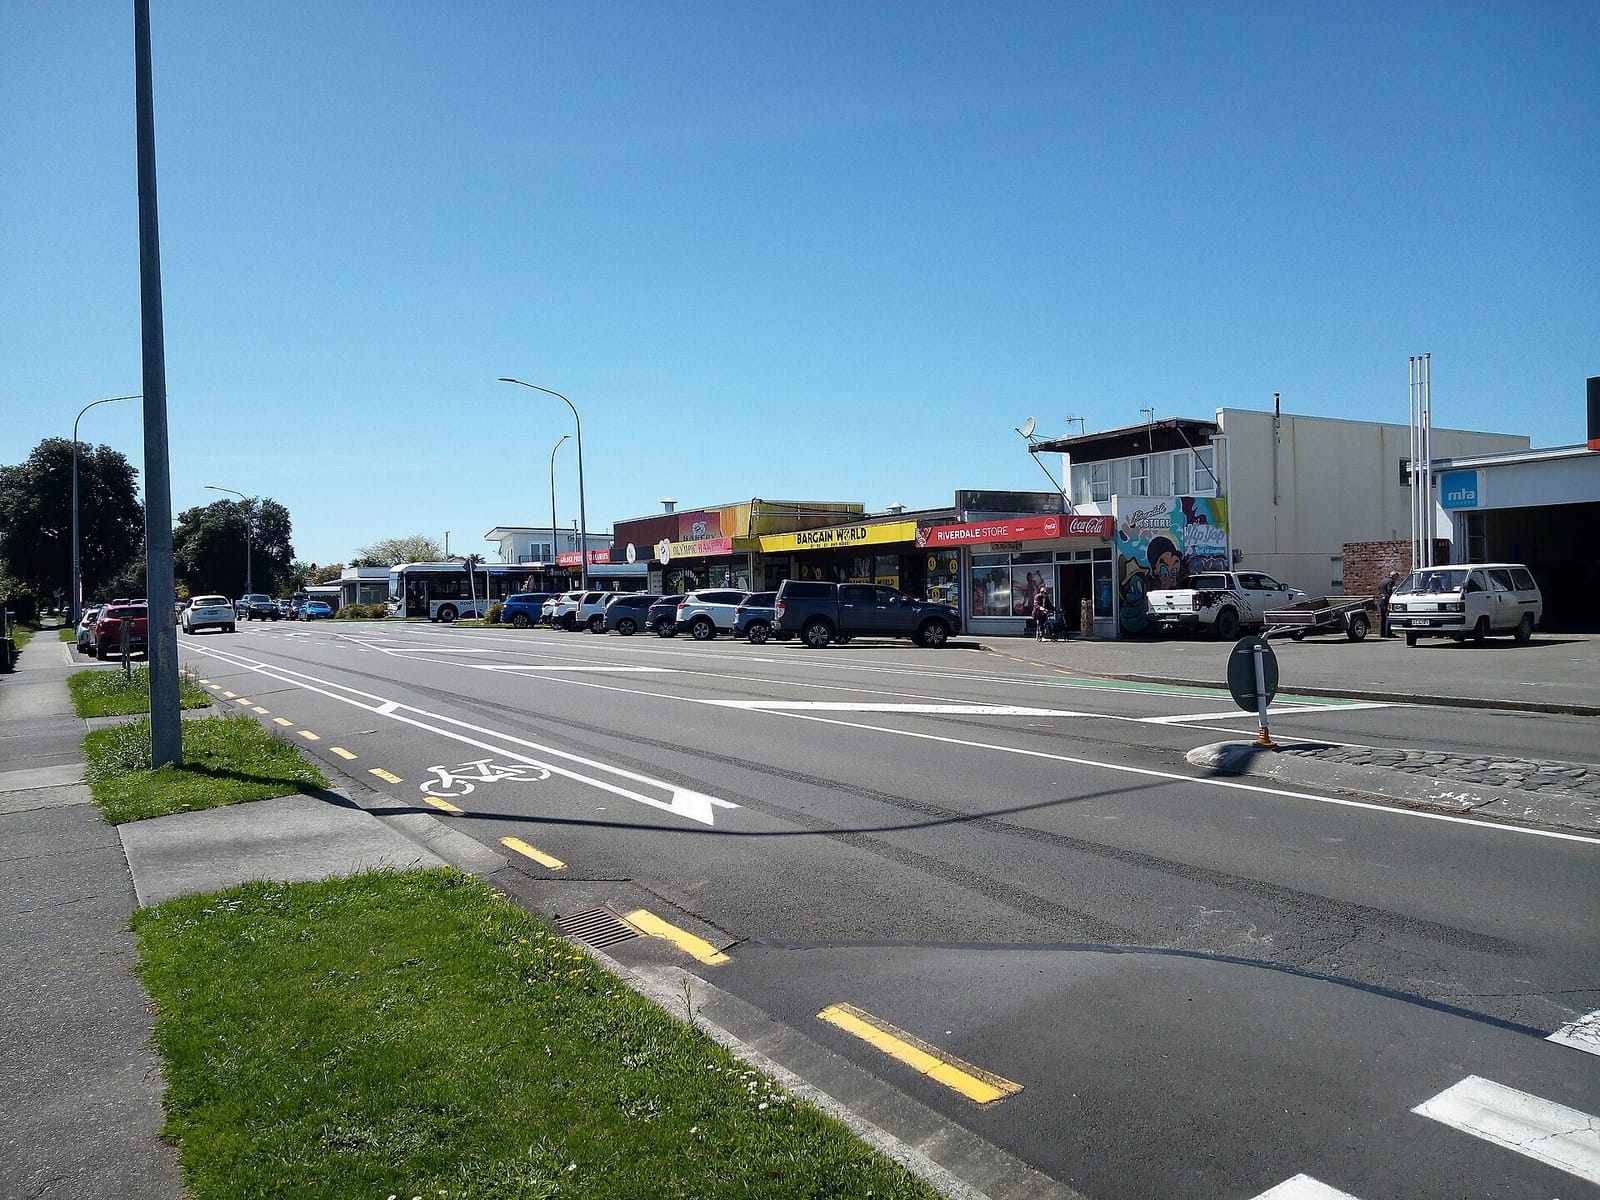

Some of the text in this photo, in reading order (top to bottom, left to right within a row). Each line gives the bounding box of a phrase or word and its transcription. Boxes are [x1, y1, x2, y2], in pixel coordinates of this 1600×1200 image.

[1448, 488, 1475, 501] mta
[1143, 519, 1172, 529] STORE
[797, 527, 867, 545] BARGAIN WORLD
[937, 529, 981, 541] RIVERDALE
[982, 526, 1009, 537] STORE
[672, 541, 724, 556] OLYMPIC BAKERY
